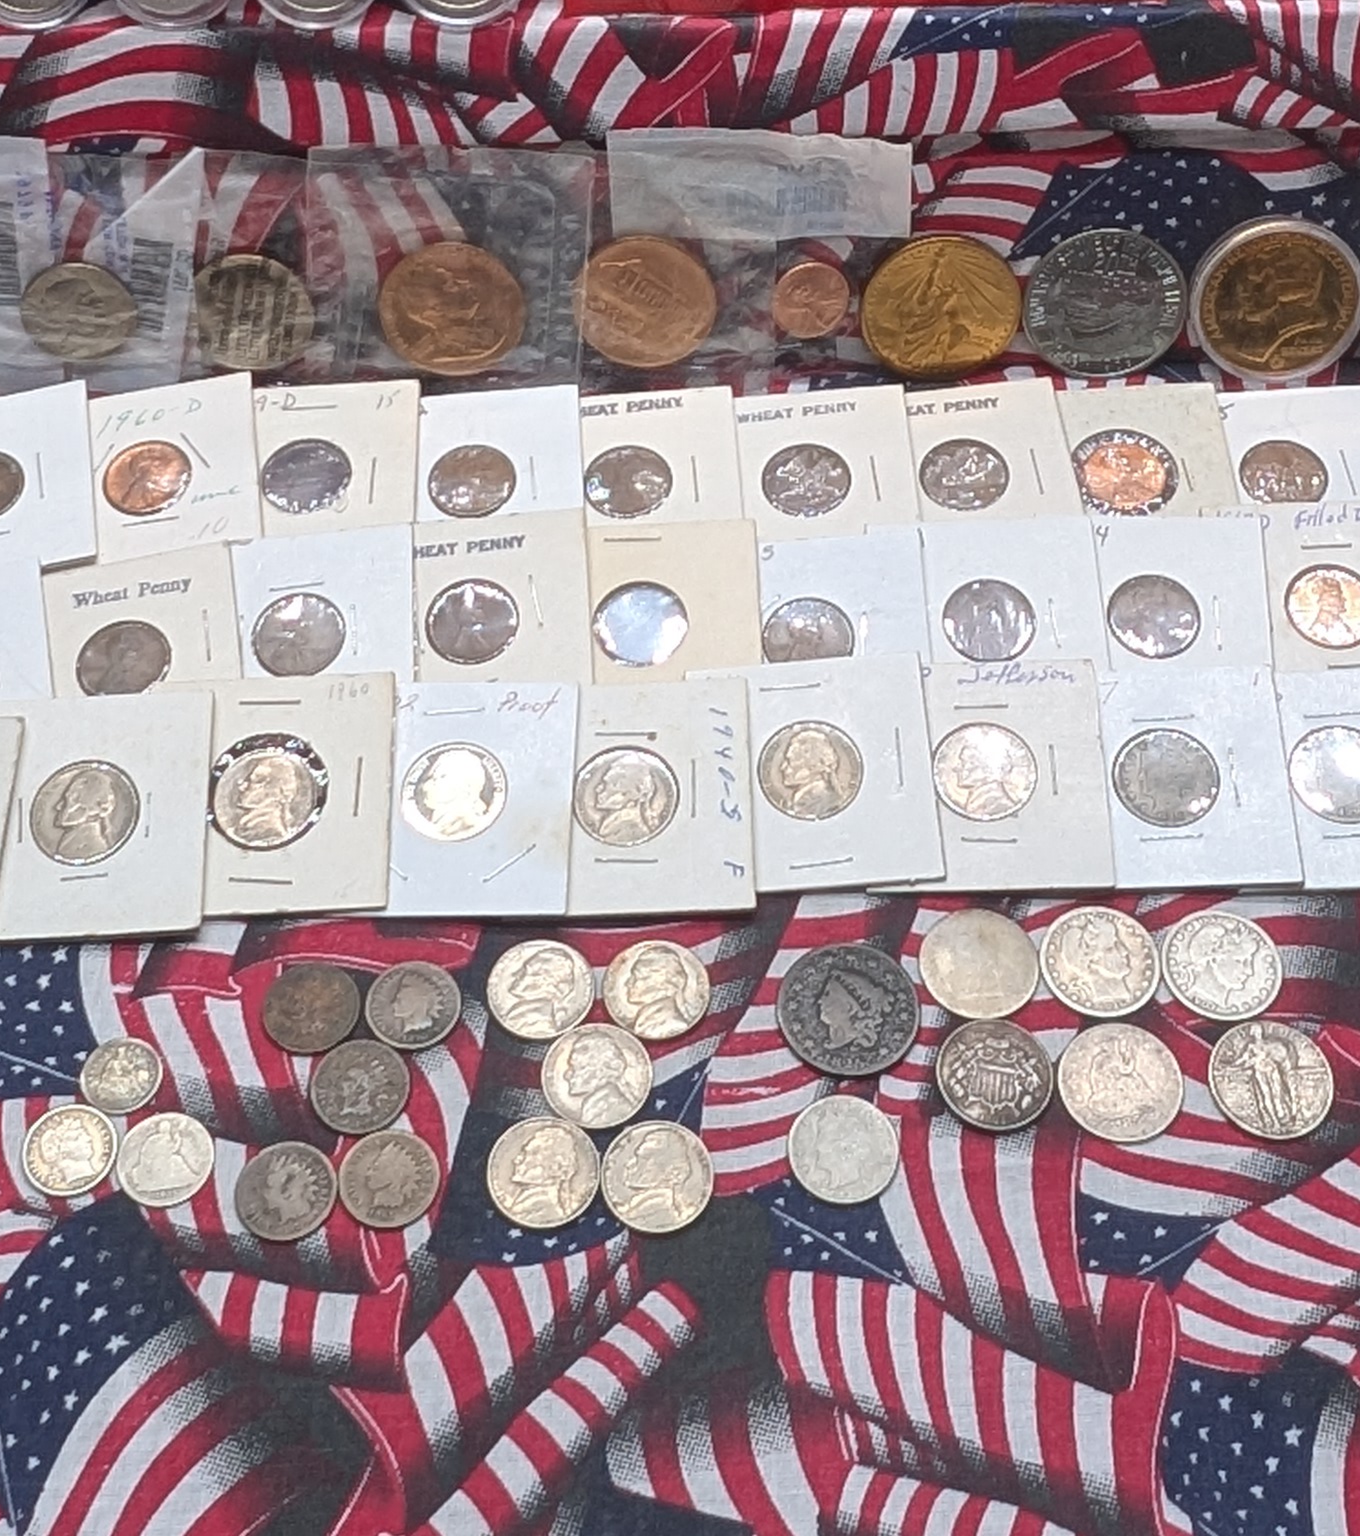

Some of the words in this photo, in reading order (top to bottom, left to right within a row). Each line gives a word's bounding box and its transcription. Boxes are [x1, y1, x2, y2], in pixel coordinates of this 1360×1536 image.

[626, 395, 683, 413] PENNY
[737, 404, 796, 425] WHEAT
[801, 399, 858, 418] PENNY
[943, 396, 1000, 413] PENNY
[466, 534, 526, 554] PENNY
[72, 589, 129, 610] Wheat
[138, 574, 193, 599] Penny
[496, 686, 562, 718] Proof
